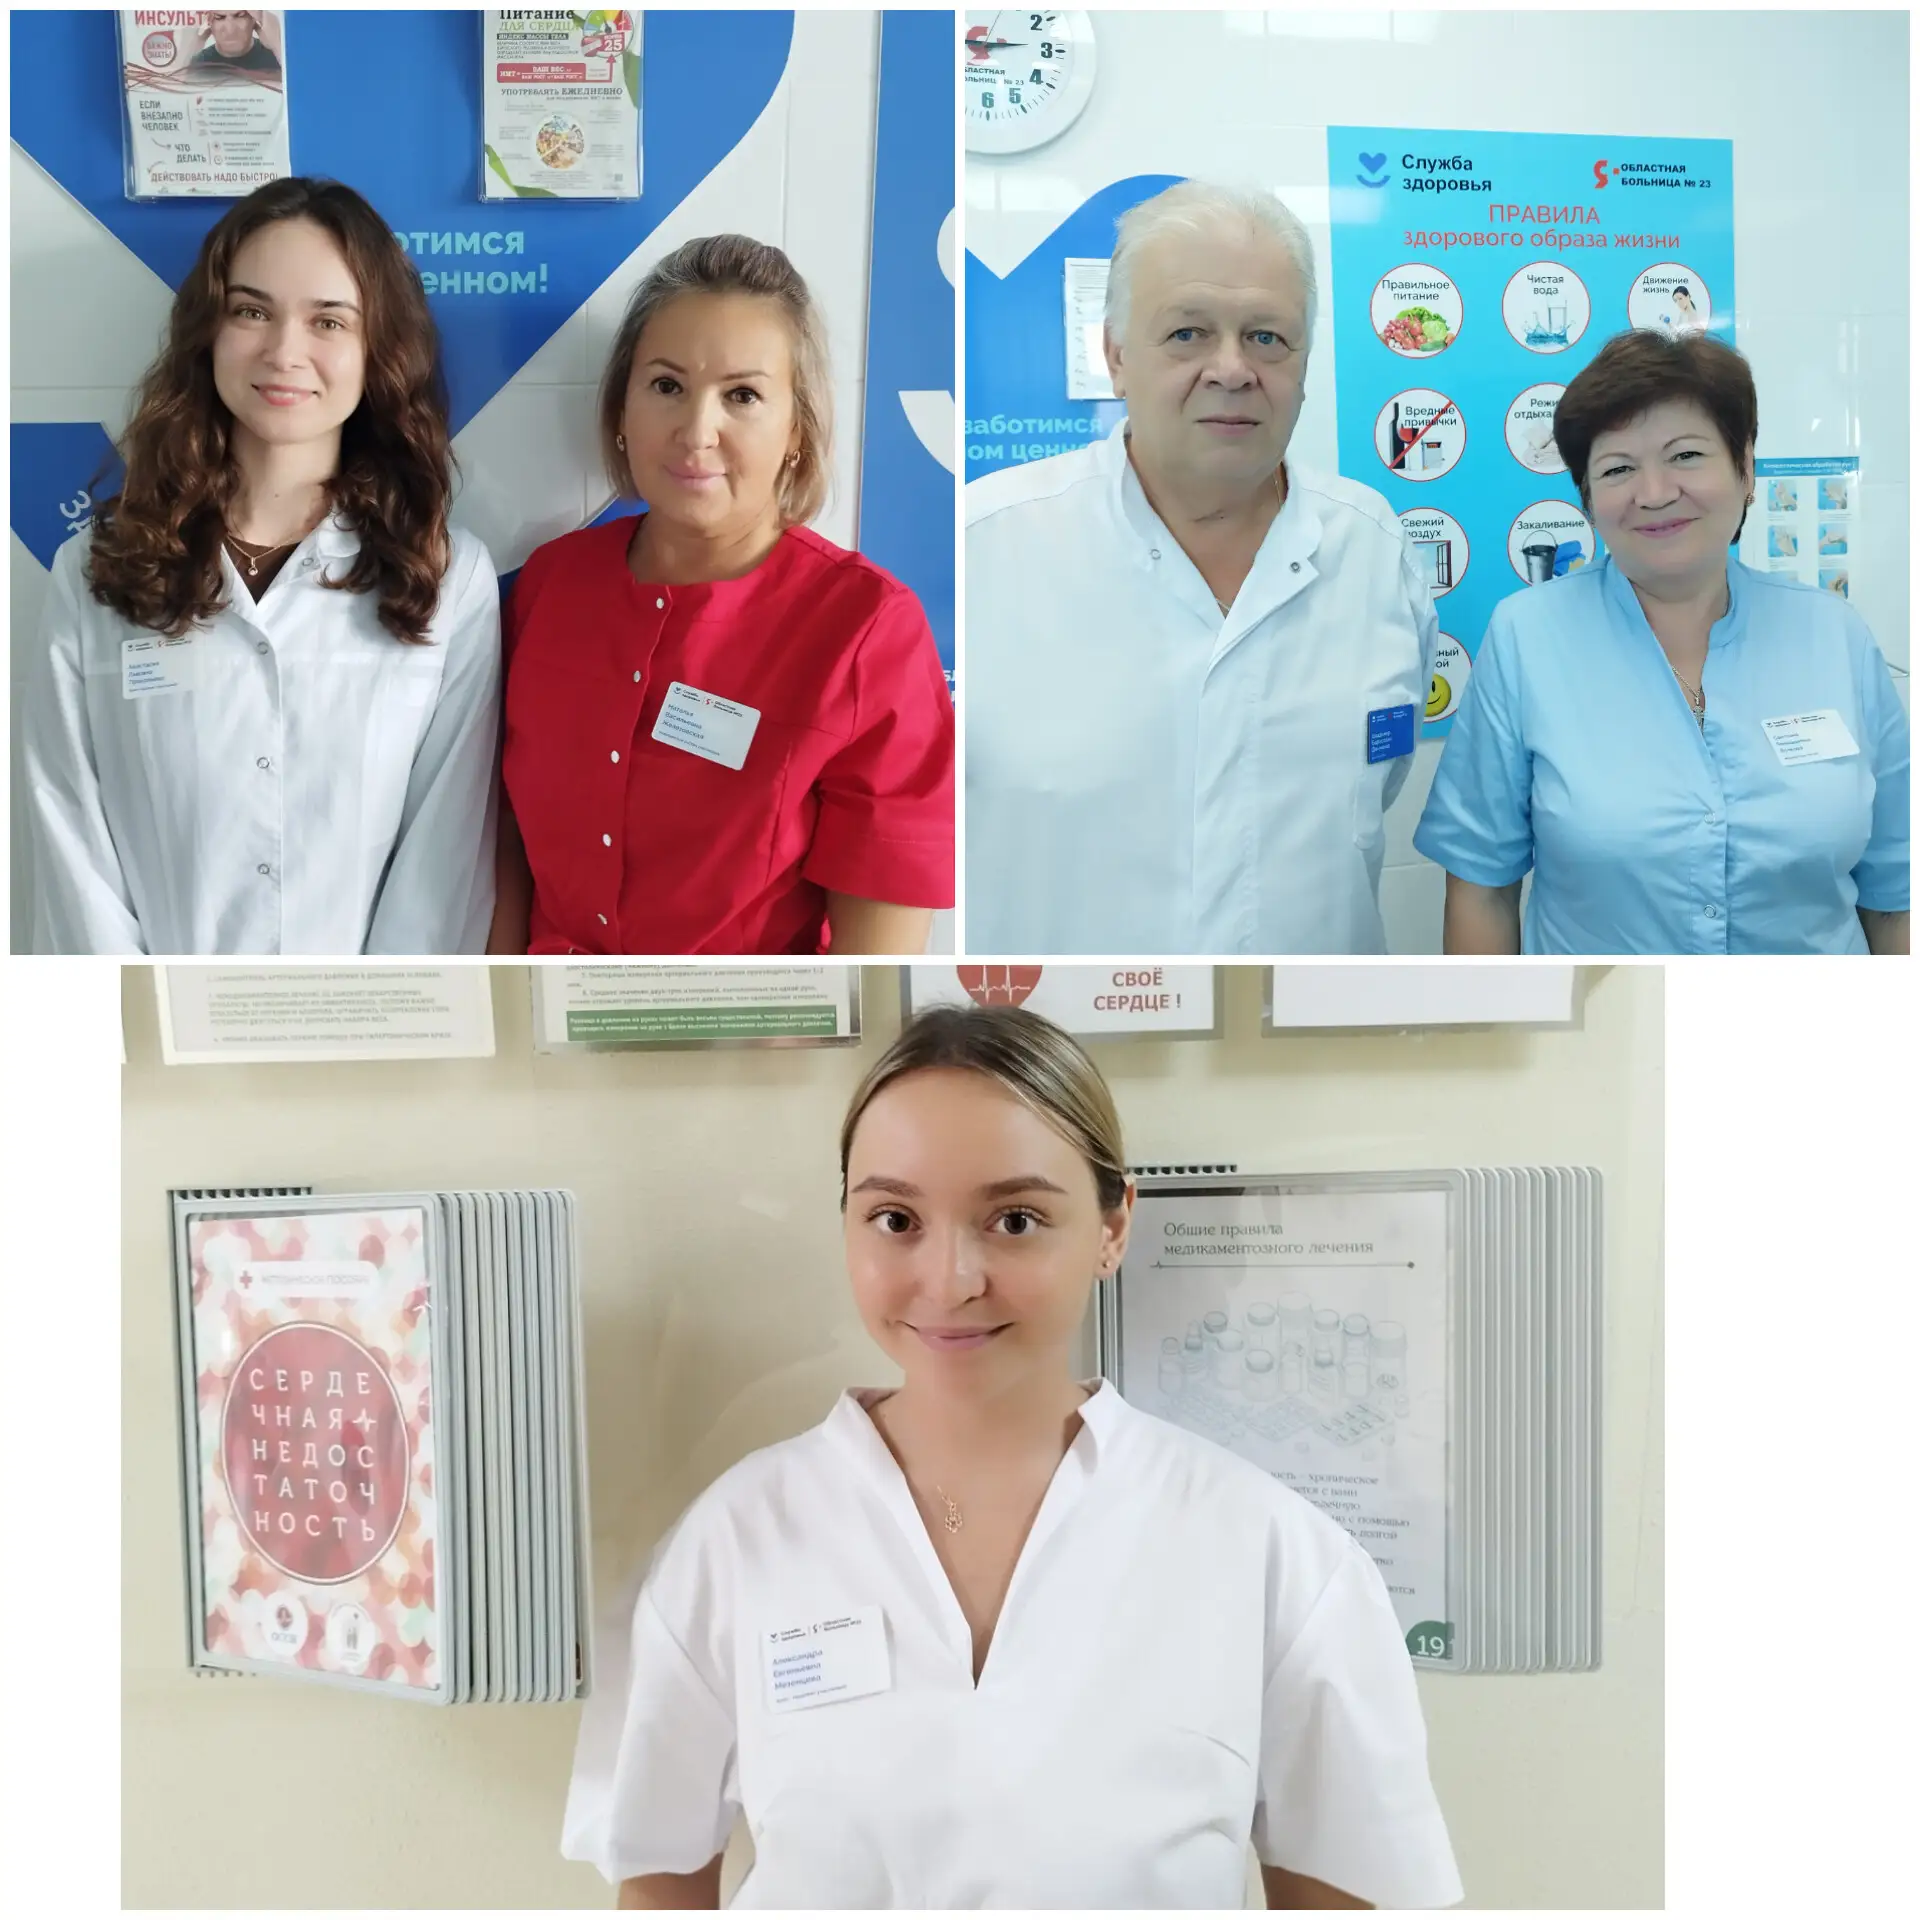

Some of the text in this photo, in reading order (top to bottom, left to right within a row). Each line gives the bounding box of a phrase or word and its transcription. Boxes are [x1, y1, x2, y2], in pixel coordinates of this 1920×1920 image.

[500, 10, 575, 20] Питание
[1030, 14, 1043, 31] 2
[604, 40, 623, 51] 25
[1041, 42, 1053, 59] 3
[1029, 69, 1044, 85] 4
[561, 87, 623, 96] ЕЖЕДНЕВНО
[1009, 87, 1022, 104] 5
[139, 100, 161, 110] ЕСЛИ
[981, 92, 995, 108] 6
[141, 111, 184, 121] ВНЕЗАПНО
[142, 122, 180, 132] ЧЕЛОВЕК
[174, 144, 191, 153] ЧТО
[176, 154, 207, 164] ДЕЛАТЬ
[1402, 154, 1473, 174] Служба
[1620, 163, 1686, 173] ОБЛАСТНАЯ
[151, 170, 278, 183] ДЕЙСТВОВАТЬ НАДО БЫСТРО!
[1621, 177, 1711, 188] БОЛЬНИЦА № 23
[1402, 178, 1492, 194] здоровья
[1489, 204, 1601, 224] ПРАВИЛА
[392, 231, 525, 255] отимся
[1403, 229, 1680, 251] здорового образа жизни
[420, 263, 548, 294] енном!
[1527, 274, 1564, 284] Чистая
[1642, 276, 1689, 285] Движение
[1382, 279, 1450, 292] Правильное
[1533, 287, 1559, 296] вода
[1393, 293, 1440, 301] питание
[1530, 398, 1559, 408] Режи
[1405, 406, 1455, 418] Вредные
[1514, 410, 1553, 419] отдыха
[1404, 418, 1457, 427] привычки
[1011, 443, 1089, 462] ценн
[1401, 516, 1444, 528] Свежий
[1517, 520, 1585, 530] Закаливание
[1436, 646, 1459, 657] ный
[1435, 658, 1450, 668] ой
[667, 703, 694, 717] Наталья
[1112, 967, 1163, 987] СВОЁ
[1093, 994, 1170, 1013] СЕРДЦЕ
[1220, 1223, 1284, 1239] правила
[1164, 1241, 1374, 1256] медикаментозного лечения
[249, 1367, 371, 1399] СЕРДЕ
[251, 1403, 343, 1430] ЧНАЯ
[252, 1438, 375, 1469] НЕДОС
[254, 1474, 375, 1505] ТАТОЧ
[255, 1510, 375, 1542] НОСТЬ
[1417, 1635, 1445, 1657] 19
